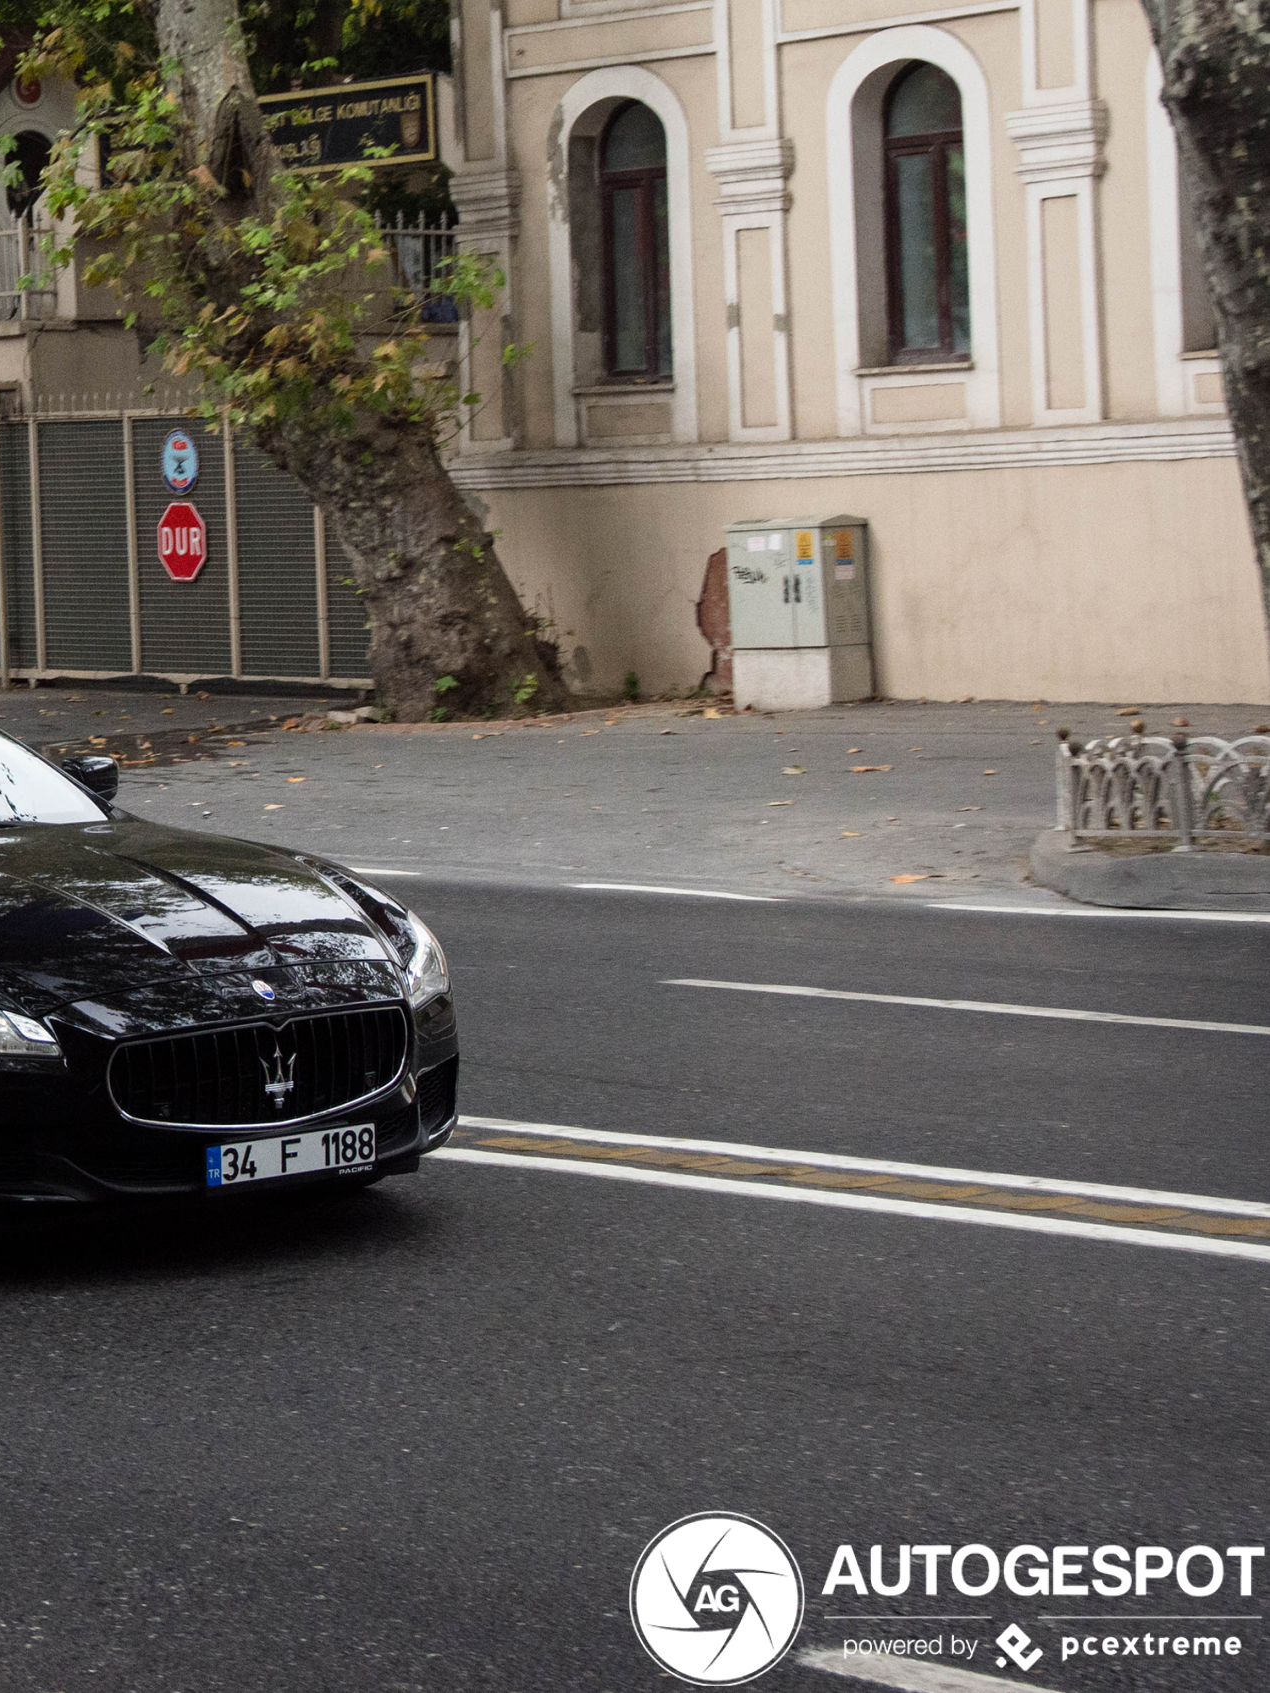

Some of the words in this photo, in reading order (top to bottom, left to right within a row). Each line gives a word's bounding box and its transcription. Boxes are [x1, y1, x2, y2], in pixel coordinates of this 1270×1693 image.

[161, 526, 203, 556] DUR
[208, 1168, 221, 1179] TR
[222, 1145, 257, 1182] 34
[281, 1138, 301, 1173] F
[322, 1127, 374, 1167] 1188
[338, 1164, 373, 1175] PACIFIC
